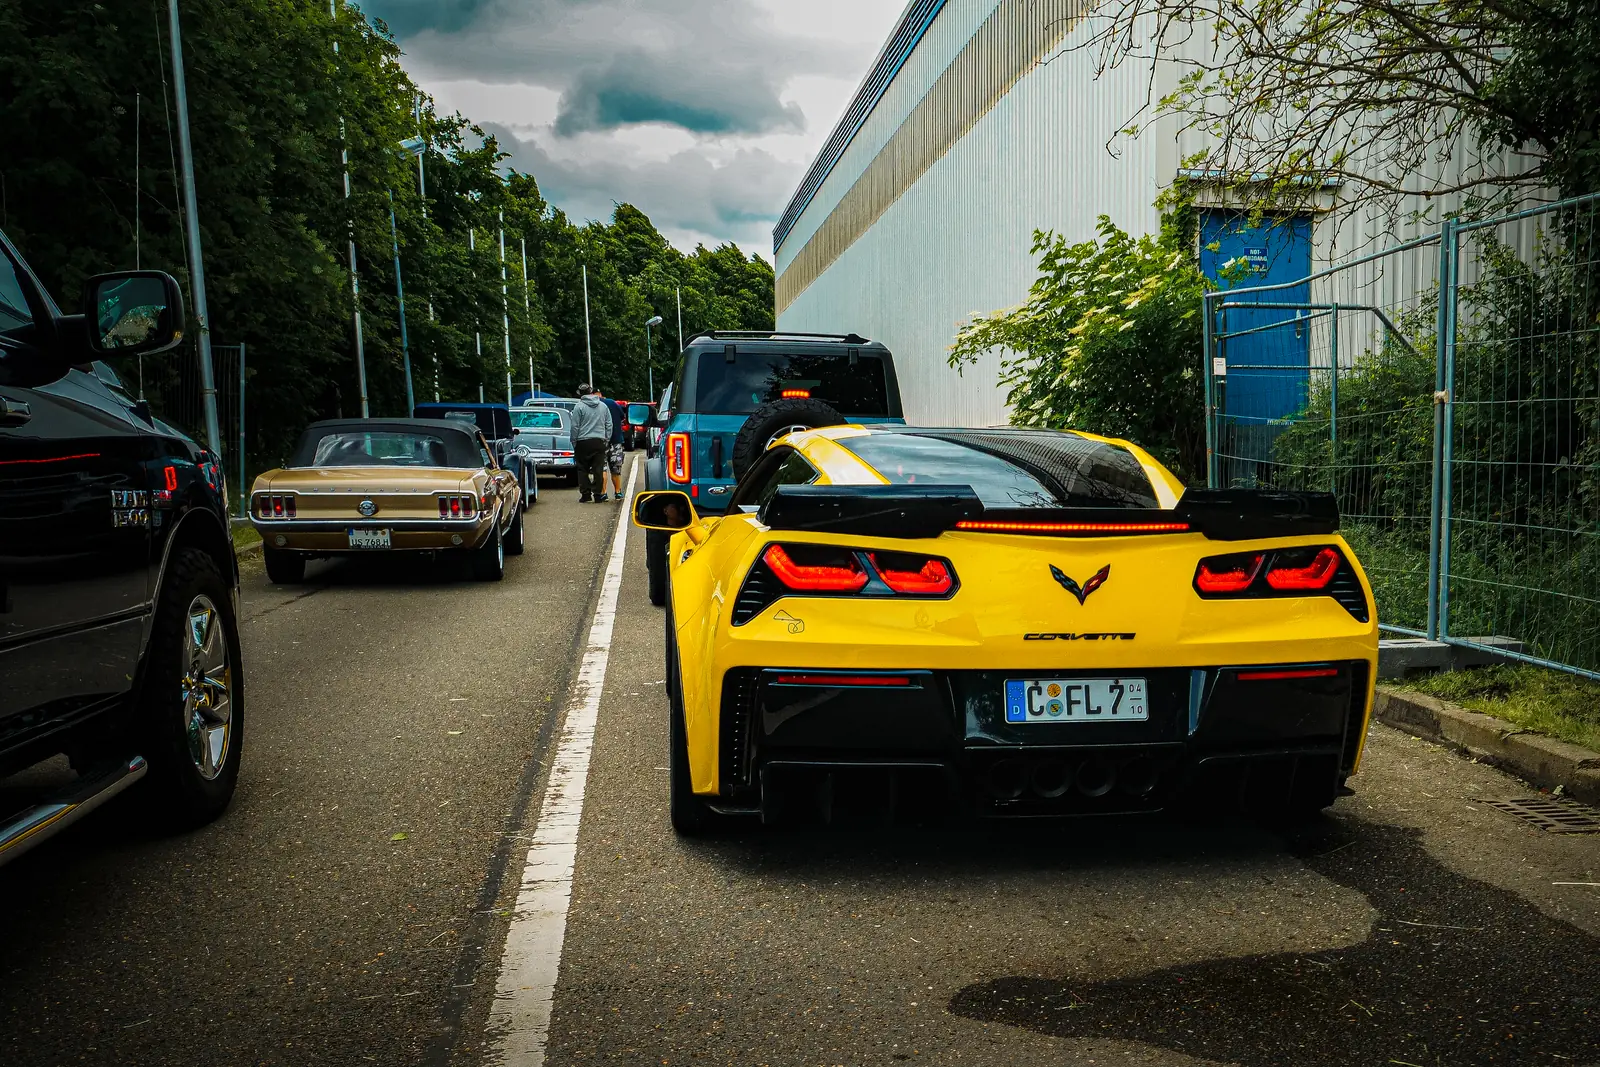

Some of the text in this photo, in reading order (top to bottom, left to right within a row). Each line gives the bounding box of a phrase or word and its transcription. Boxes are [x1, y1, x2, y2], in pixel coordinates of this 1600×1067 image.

[1129, 684, 1142, 693] 04
[1027, 684, 1125, 716] C FL 7
[1012, 705, 1021, 715] D
[1130, 705, 1143, 715] 10
